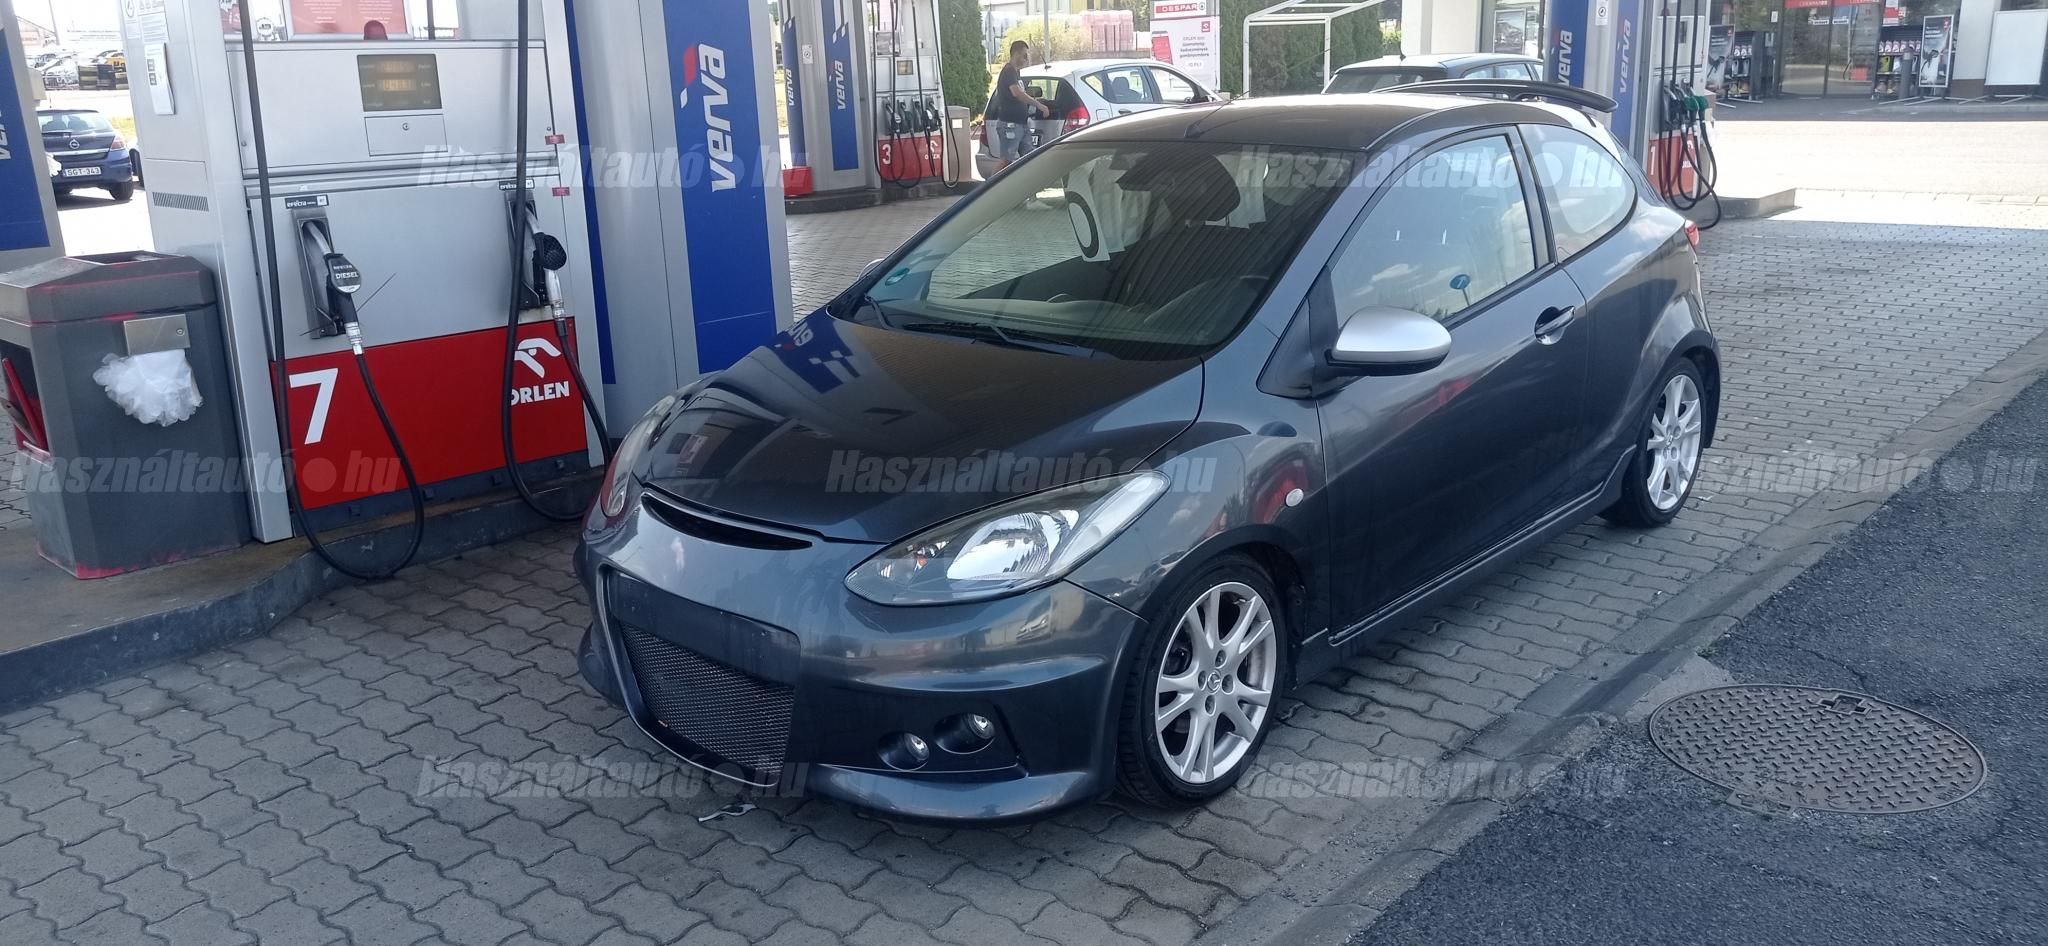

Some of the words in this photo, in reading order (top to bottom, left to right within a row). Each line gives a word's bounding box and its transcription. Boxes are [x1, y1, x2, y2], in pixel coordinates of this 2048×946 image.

[1161, 3, 1197, 12] DESPAR
[1558, 30, 1573, 87] verva
[1620, 19, 1631, 93] verva
[785, 68, 795, 106] verva
[834, 60, 847, 110] verva
[698, 43, 737, 192] verva
[882, 143, 891, 165] 3
[1651, 145, 1656, 176] 1
[335, 271, 359, 279] DIESEL
[288, 367, 339, 445] 7
